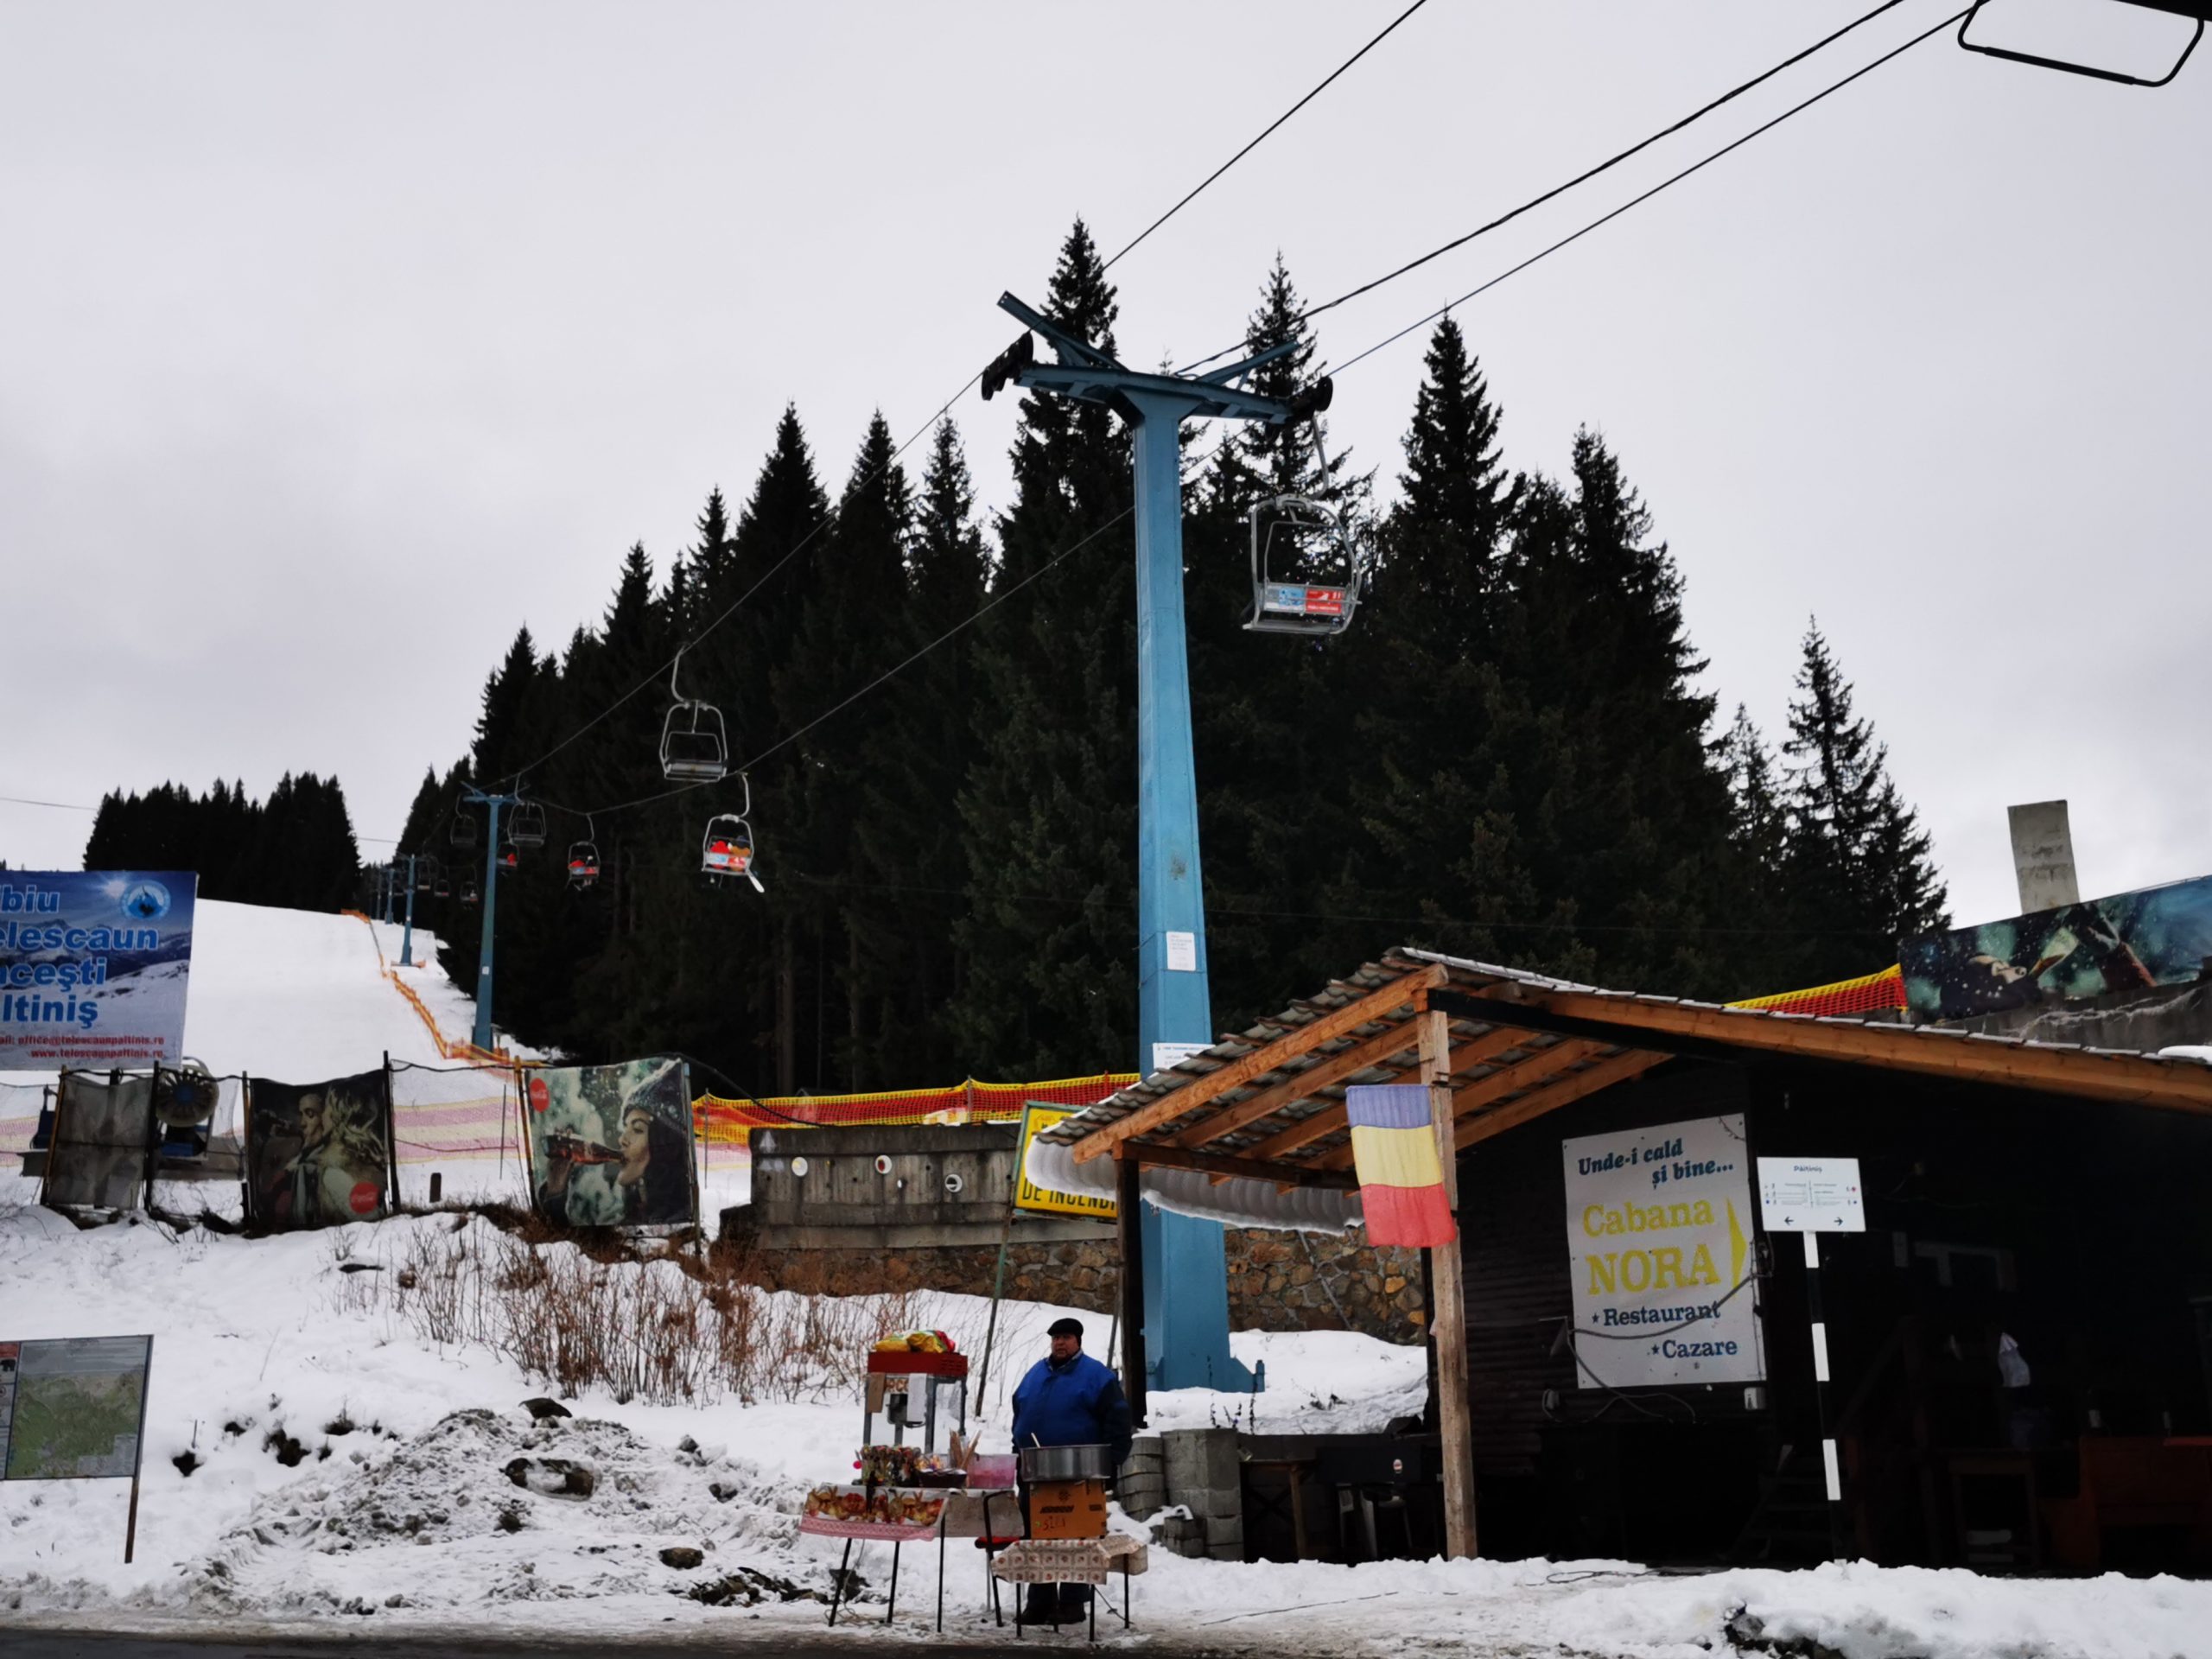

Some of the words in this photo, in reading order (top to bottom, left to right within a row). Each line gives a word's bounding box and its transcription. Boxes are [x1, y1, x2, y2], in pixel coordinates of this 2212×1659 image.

[0, 884, 60, 913] biu
[1578, 1147, 1638, 1176] Unde-i
[1643, 1137, 1684, 1163] cald
[1673, 1159, 1733, 1181] bine...
[1583, 1198, 1715, 1238] Cabana
[1585, 1243, 1721, 1295] NORA
[1603, 1300, 1721, 1326] Restaurant
[1662, 1339, 1738, 1358] Cazare
